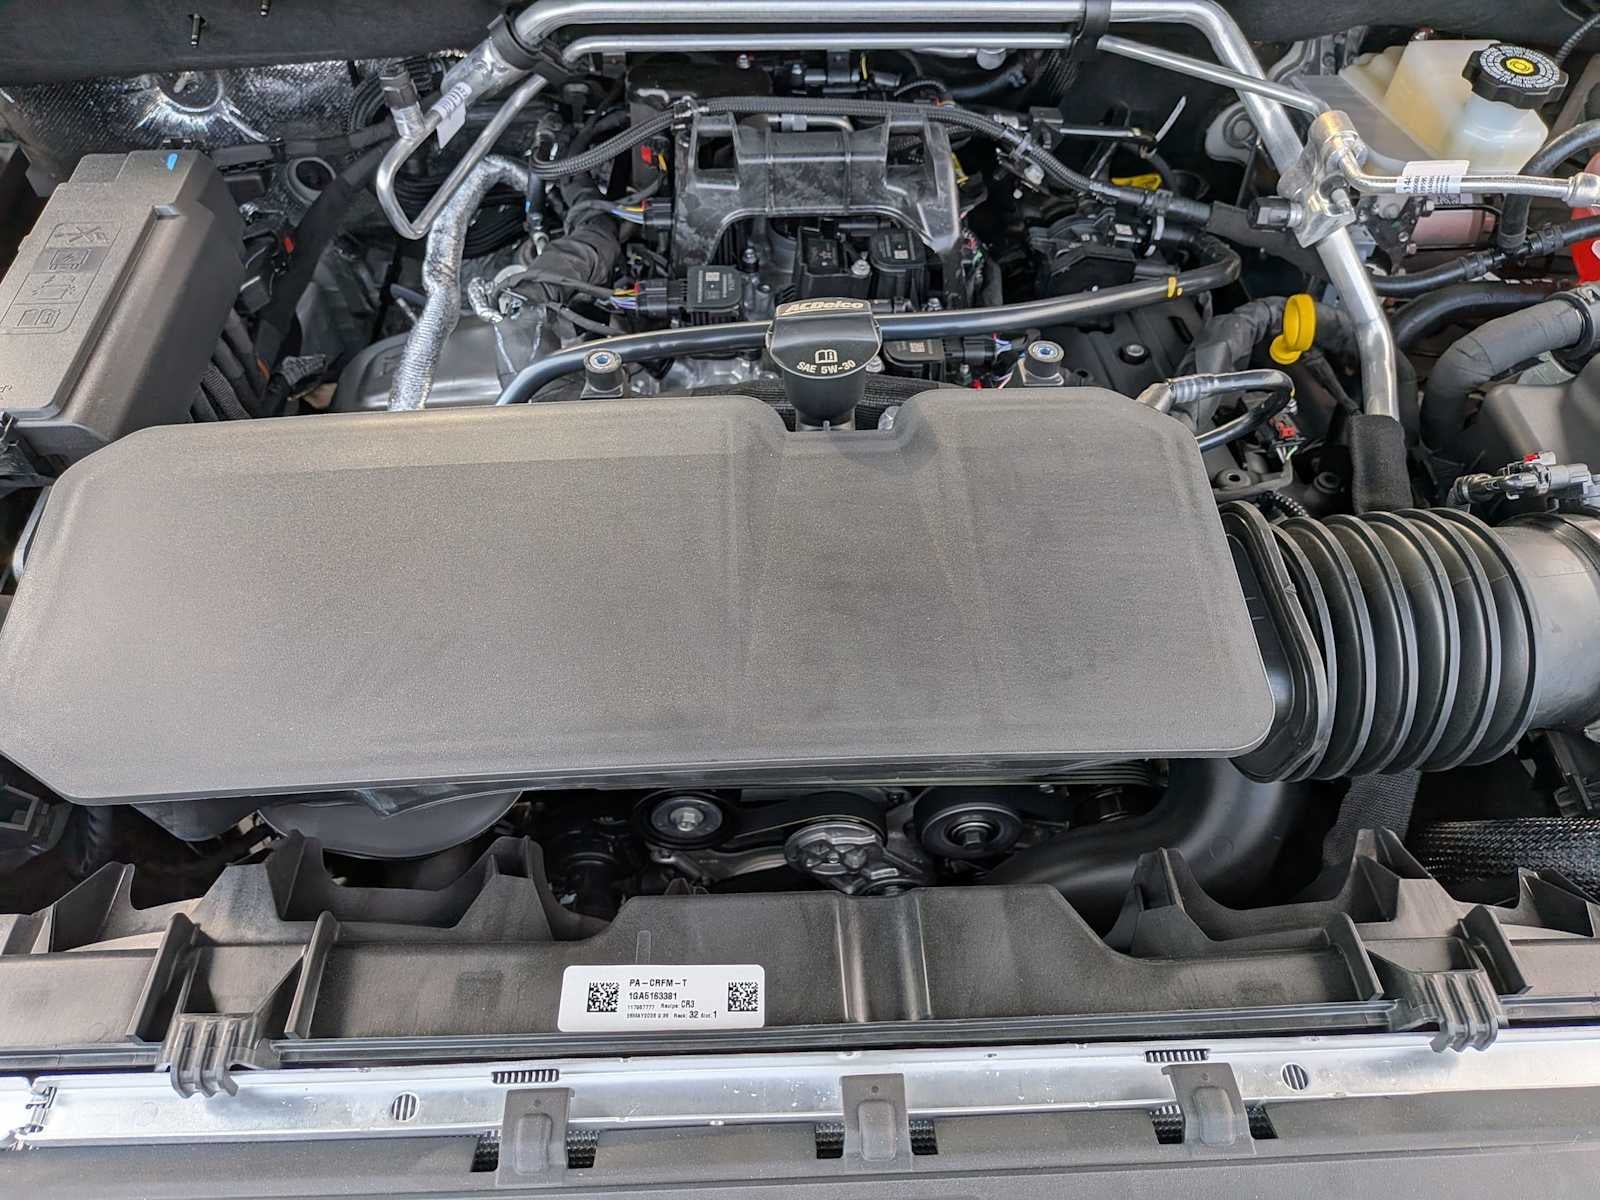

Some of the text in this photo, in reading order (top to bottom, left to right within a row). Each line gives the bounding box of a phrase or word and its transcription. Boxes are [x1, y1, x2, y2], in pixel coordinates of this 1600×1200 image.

[783, 301, 864, 313] ACDelco
[797, 360, 856, 374] SAE 5W-30
[681, 1000, 695, 1008] CR3
[689, 1010, 699, 1019] 32
[713, 1010, 717, 1018] 1
